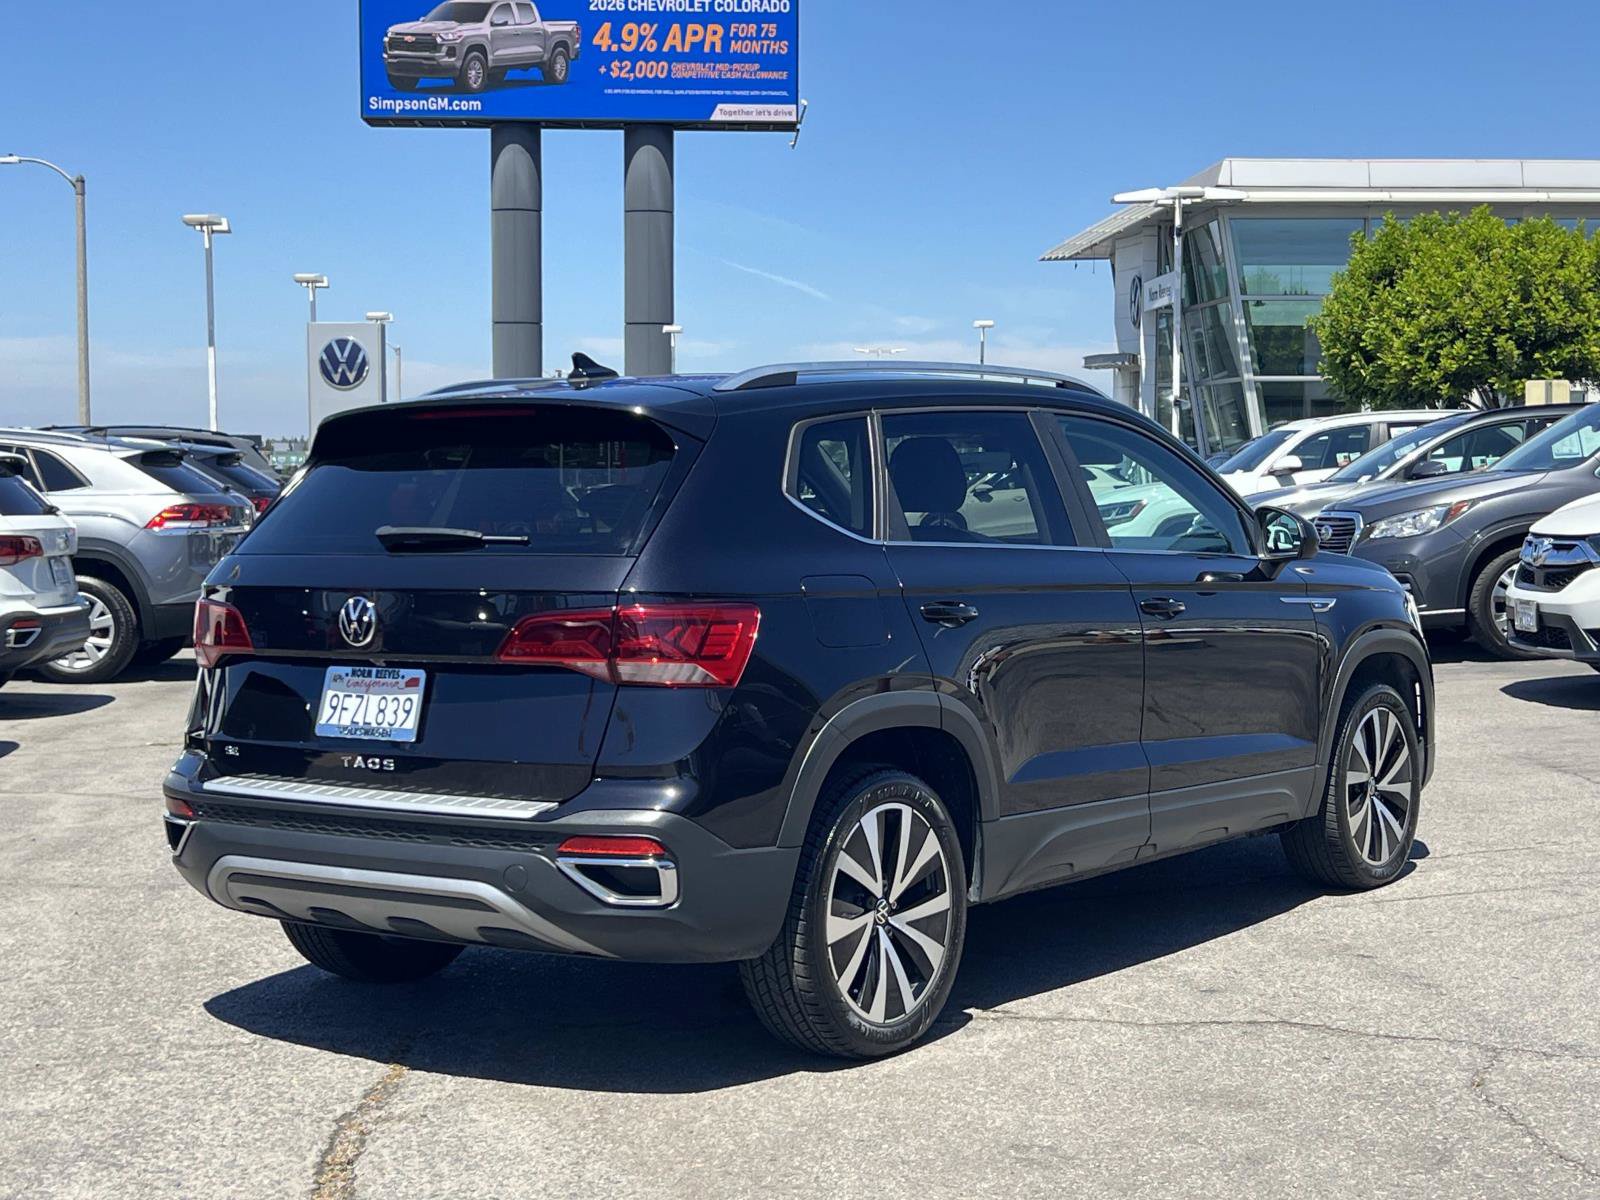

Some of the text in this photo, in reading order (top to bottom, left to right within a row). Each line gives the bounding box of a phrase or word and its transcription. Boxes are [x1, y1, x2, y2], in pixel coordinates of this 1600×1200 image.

[589, 0, 790, 13] 2026 CHEVROLET COLORADO
[592, 22, 724, 53] 4.9% APR
[730, 24, 777, 38] FOR 75
[730, 40, 789, 55] MONTHS
[610, 60, 668, 81] $2,000
[671, 71, 788, 79] COMPETITIVE CASH ALLOWANCE
[369, 96, 481, 114] SimpsonGM.com
[719, 108, 793, 118] Together let's drive
[351, 668, 373, 678] NORM
[375, 669, 400, 680] REEVES
[346, 679, 405, 693] California
[326, 693, 413, 727] 9FZL839
[341, 756, 395, 771] TAOS
